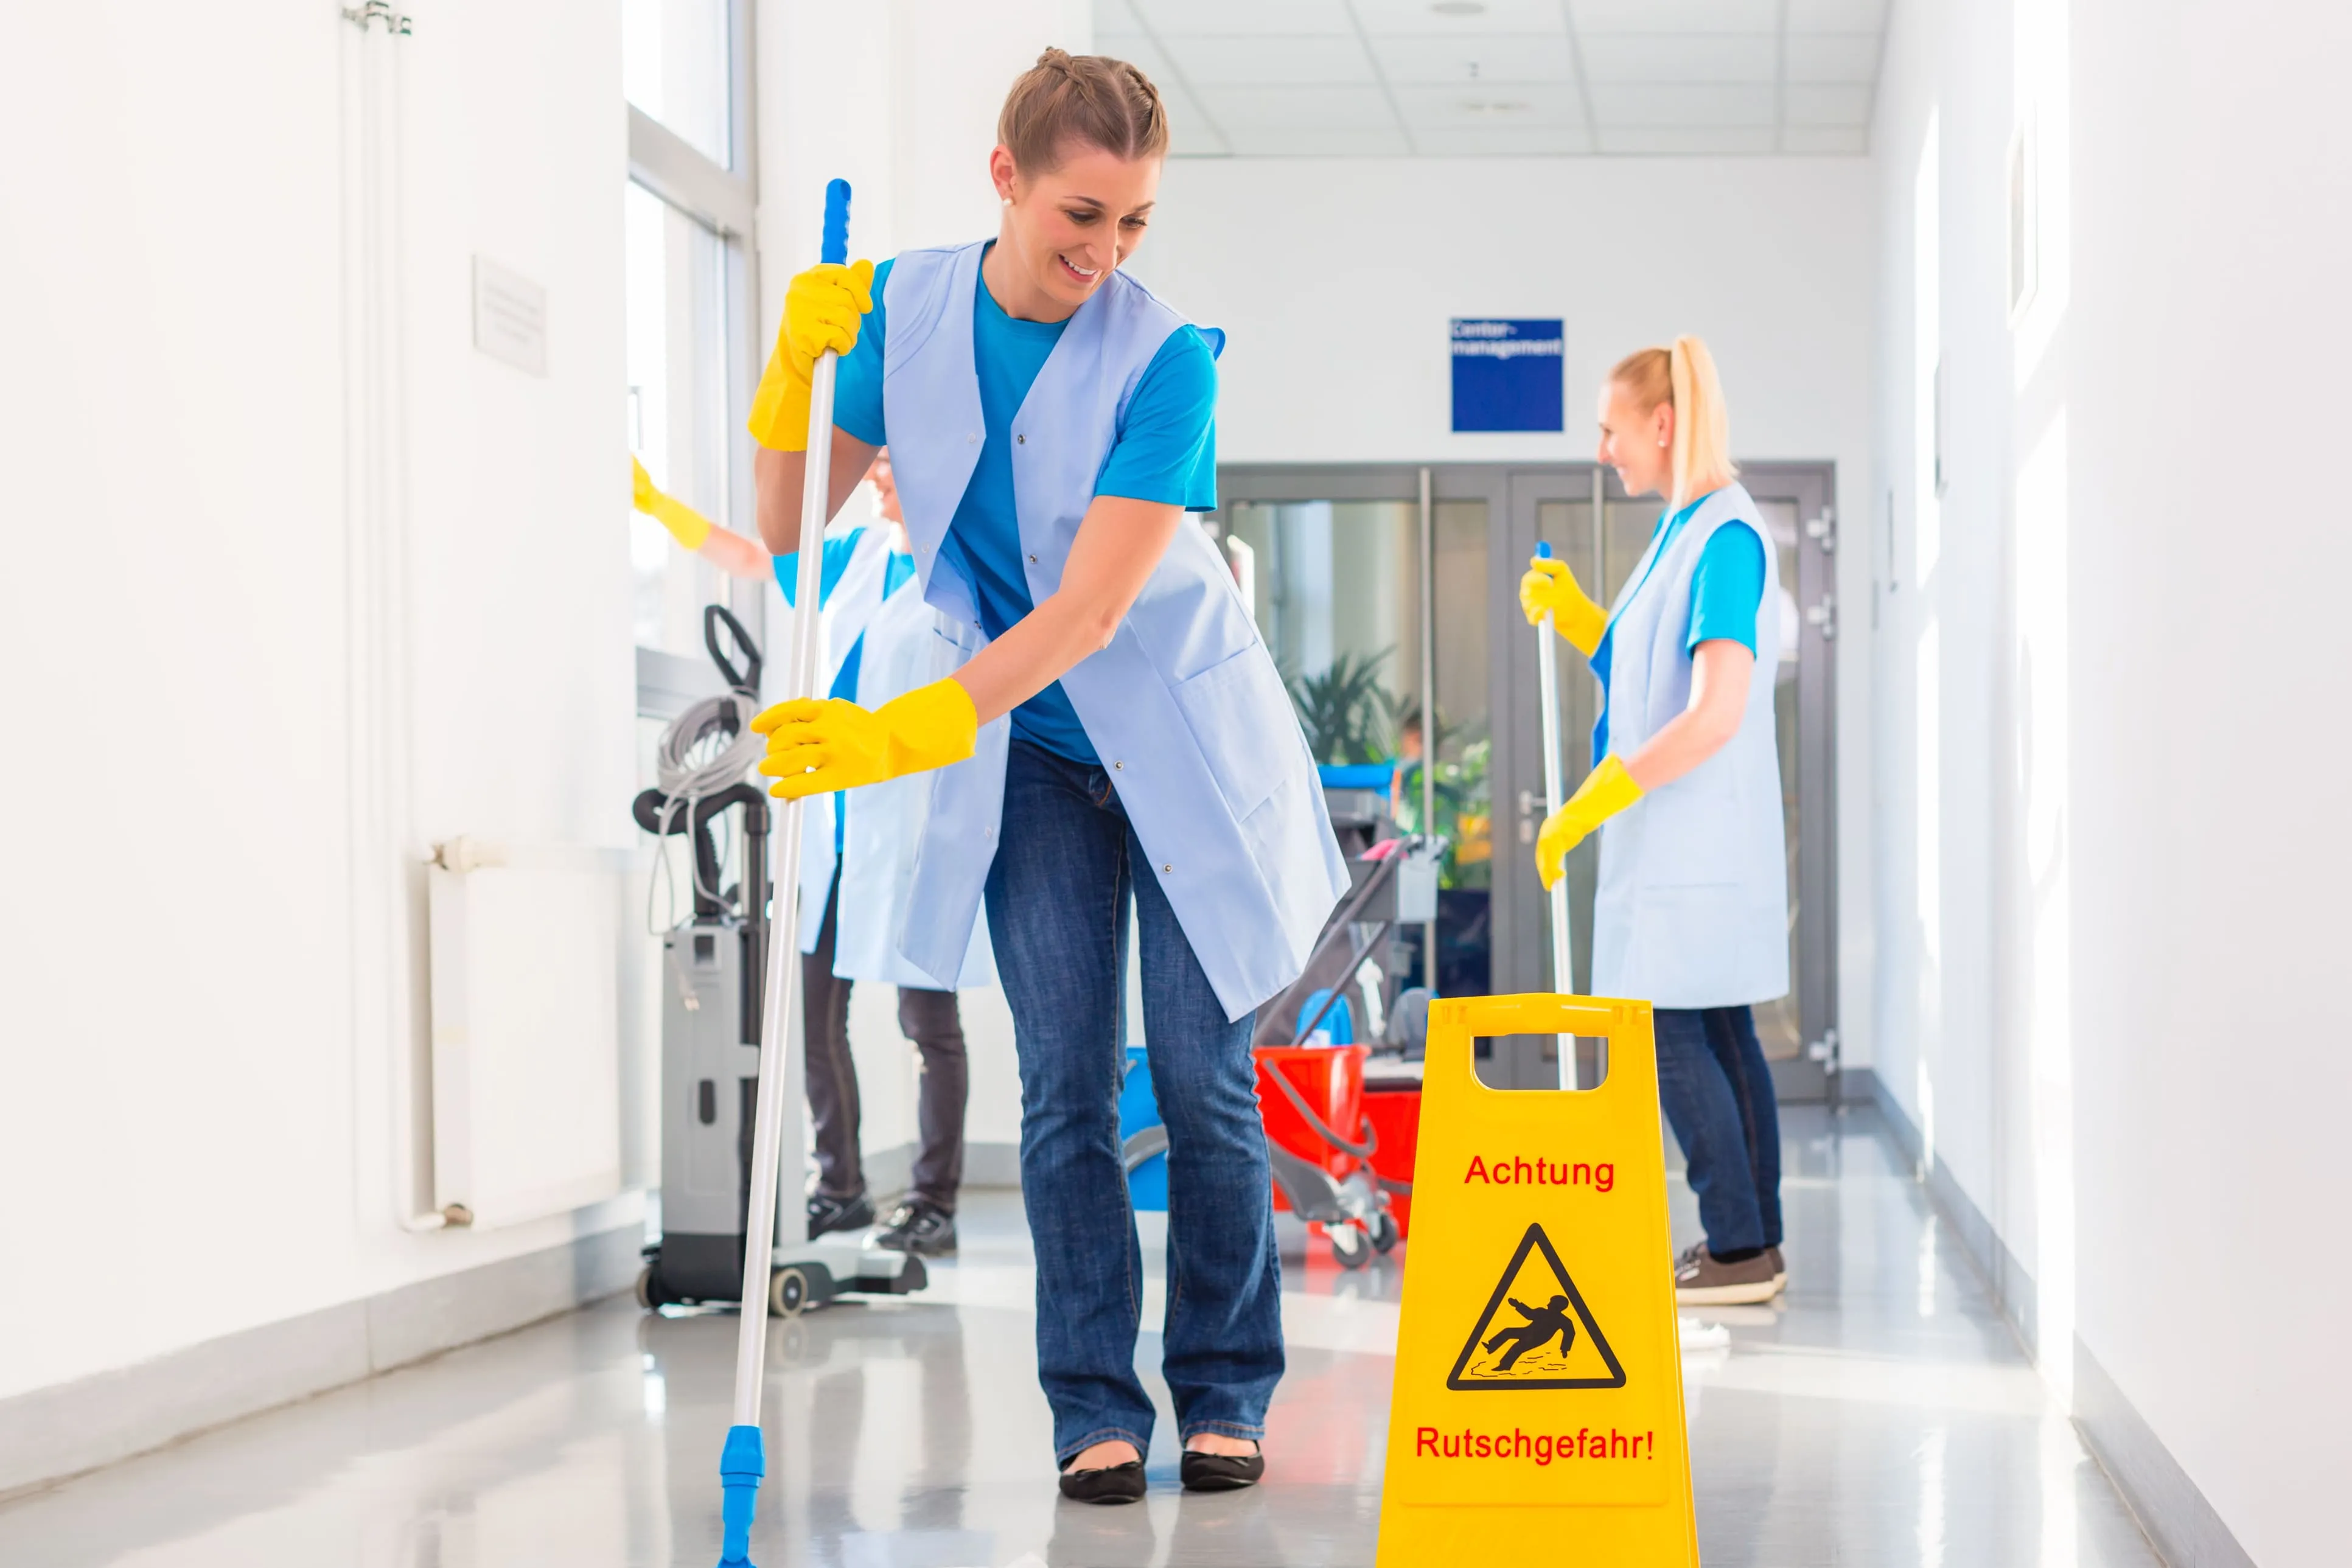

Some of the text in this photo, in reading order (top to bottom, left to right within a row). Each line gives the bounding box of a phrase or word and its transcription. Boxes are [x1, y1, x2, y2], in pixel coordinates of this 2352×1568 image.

[1452, 338, 1562, 360] management
[1464, 1155, 1614, 1193] Achtung
[1416, 1427, 1654, 1466] Rutschgefahr!
